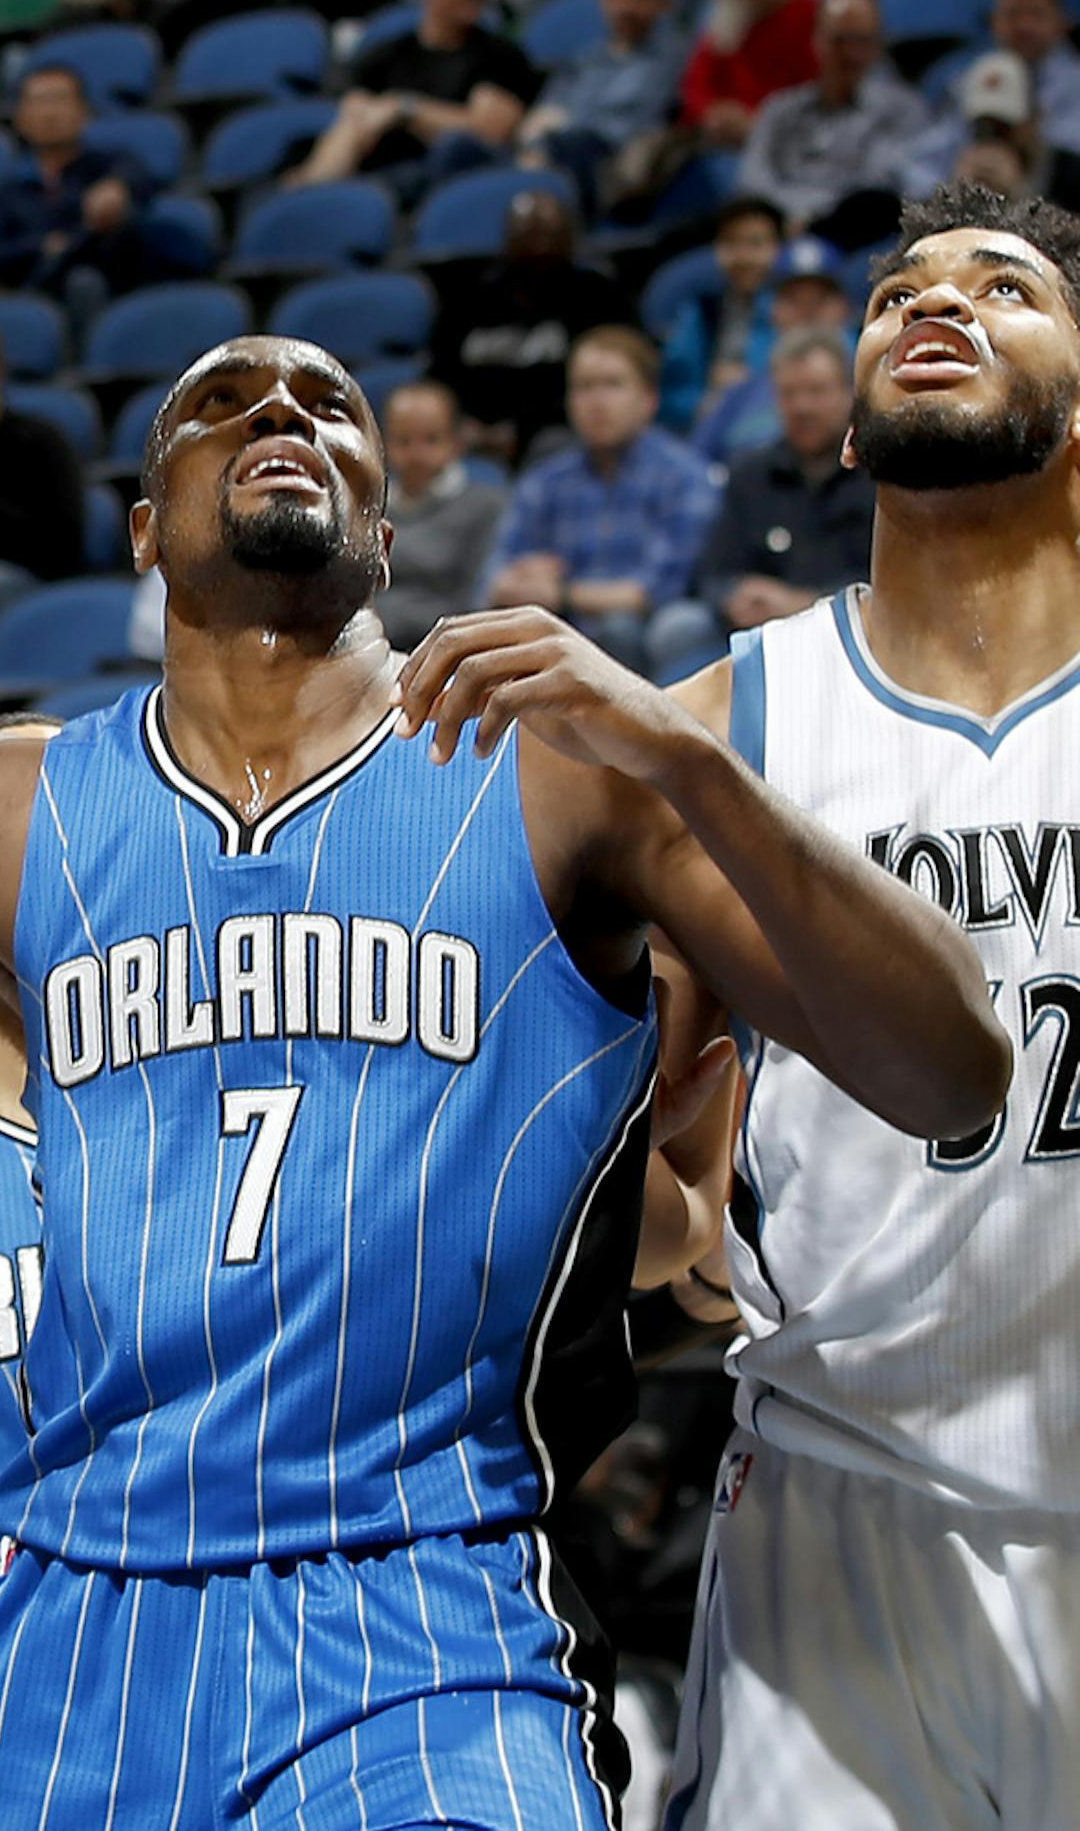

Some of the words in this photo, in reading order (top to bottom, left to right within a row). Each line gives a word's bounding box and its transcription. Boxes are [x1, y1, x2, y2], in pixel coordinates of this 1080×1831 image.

[864, 820, 1080, 956] OLV
[43, 911, 481, 1089] ORLANDO
[219, 1084, 303, 1267] 7
